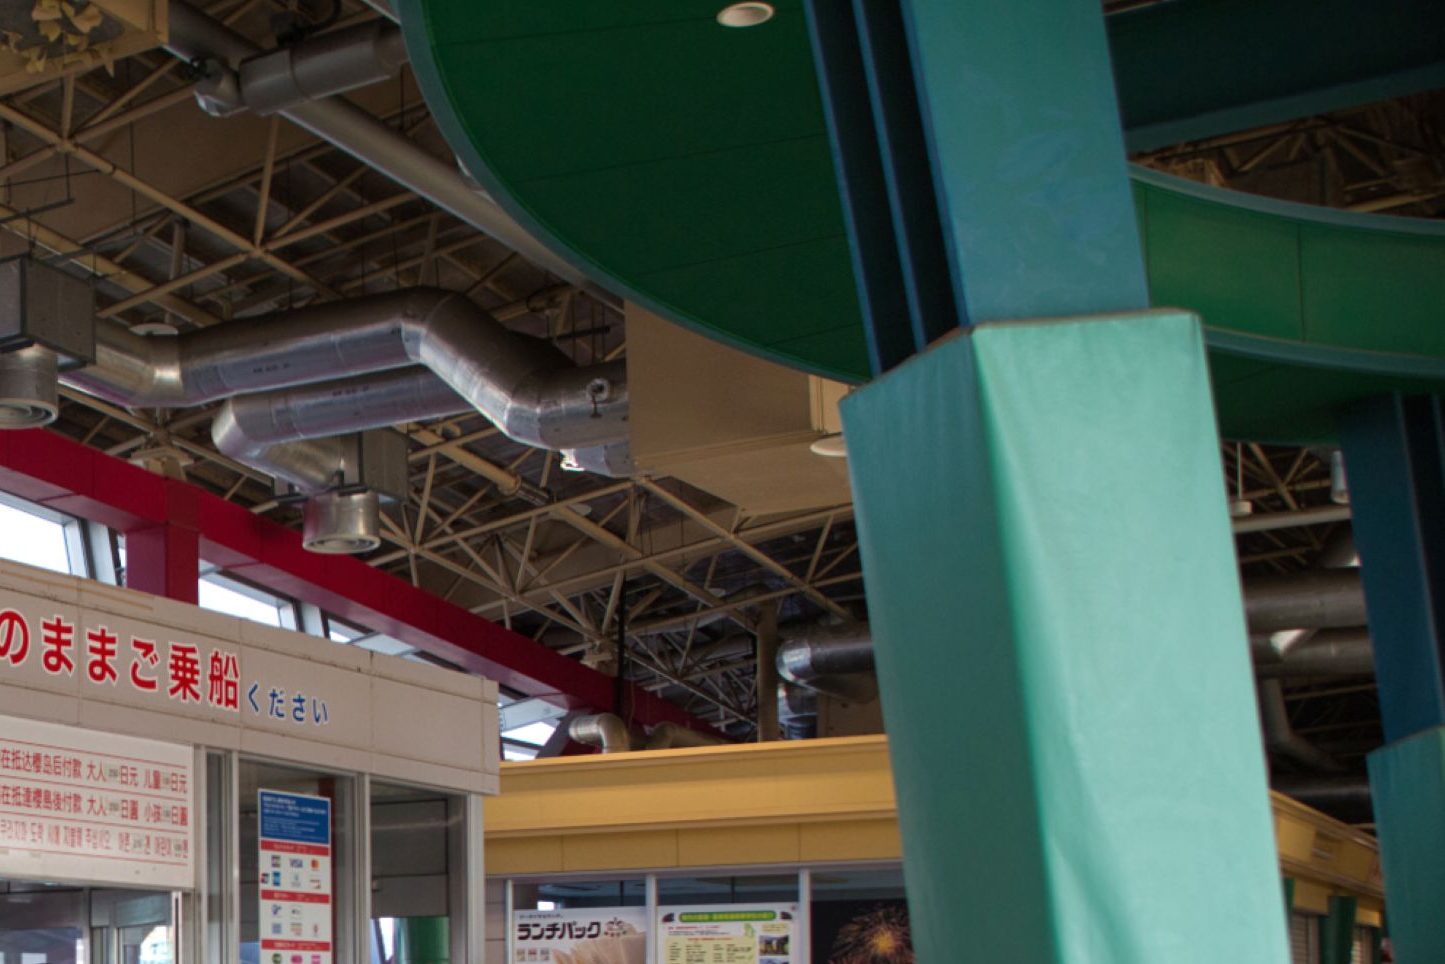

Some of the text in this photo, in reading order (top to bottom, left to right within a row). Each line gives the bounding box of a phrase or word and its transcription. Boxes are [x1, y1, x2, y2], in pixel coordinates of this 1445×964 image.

[517, 920, 602, 941] ランチパック
